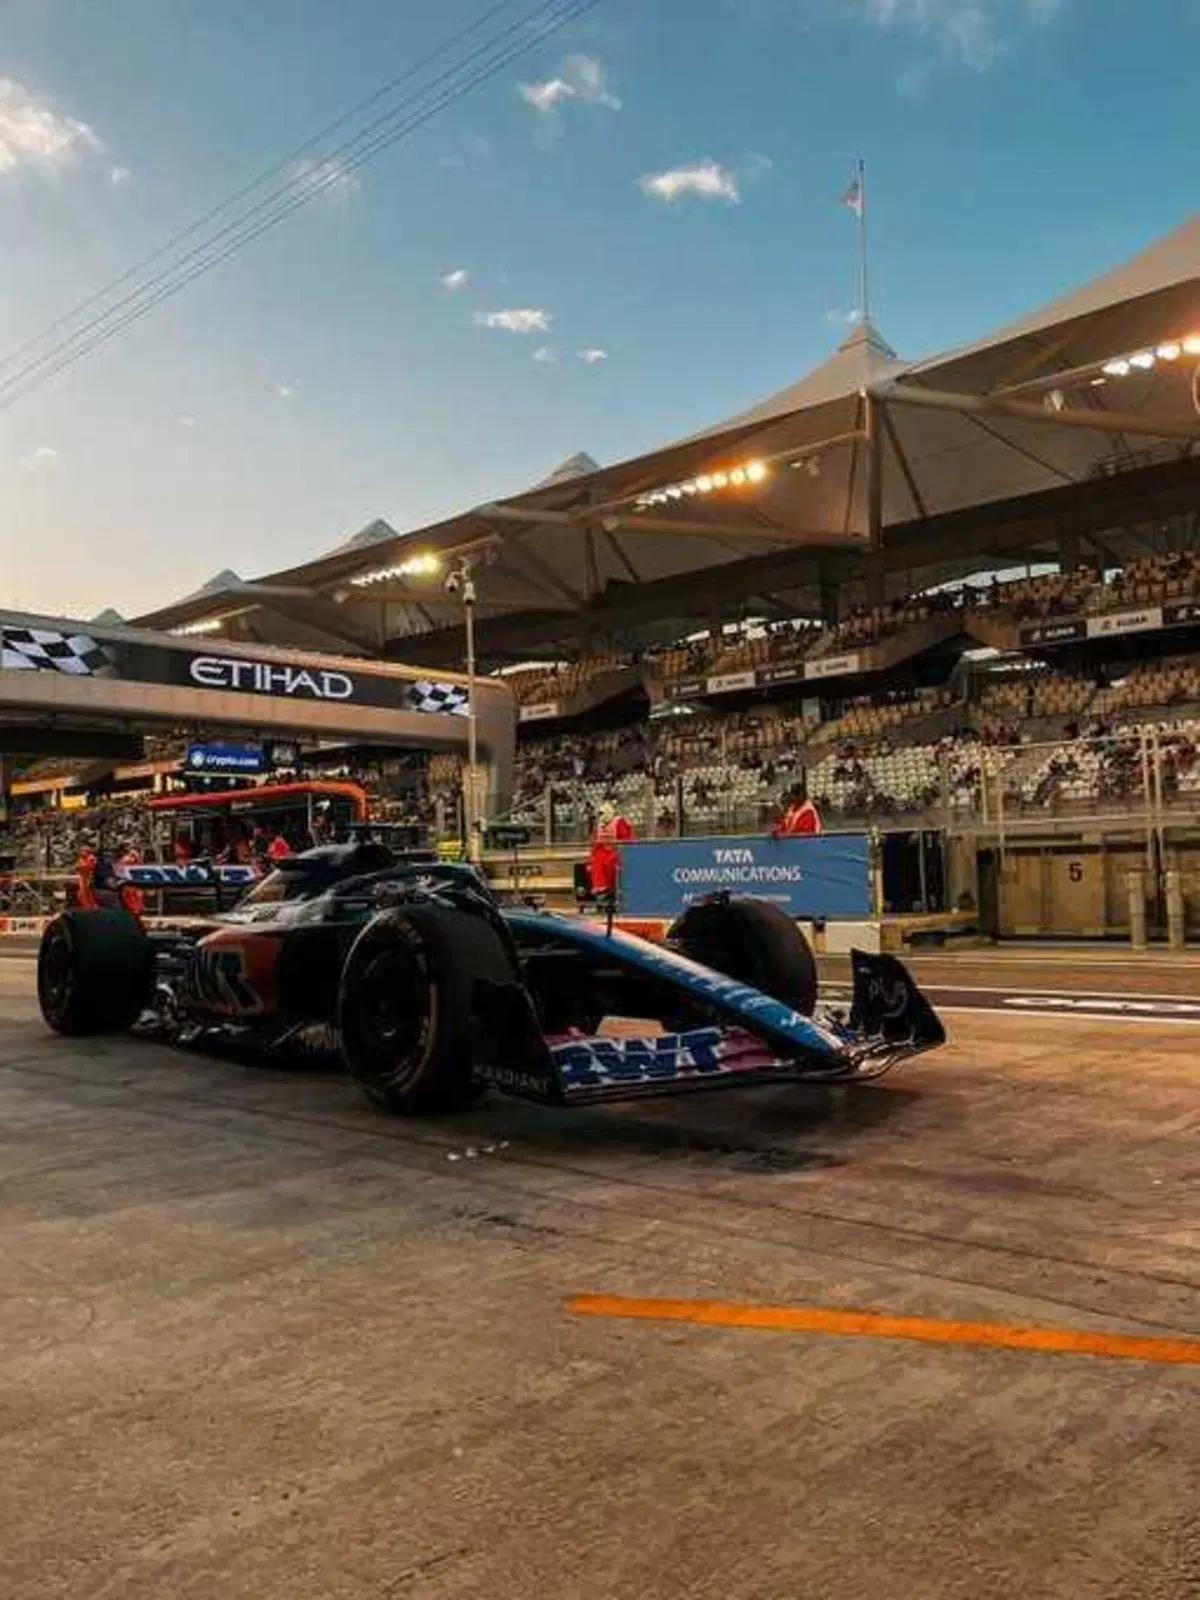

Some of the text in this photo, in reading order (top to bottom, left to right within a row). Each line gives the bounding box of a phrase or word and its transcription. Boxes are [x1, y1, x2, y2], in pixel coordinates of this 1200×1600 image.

[190, 656, 353, 699] ETIHAD
[713, 849, 754, 864] TATA
[673, 865, 803, 884] COMMUNICATIONS
[1069, 861, 1083, 883] 5
